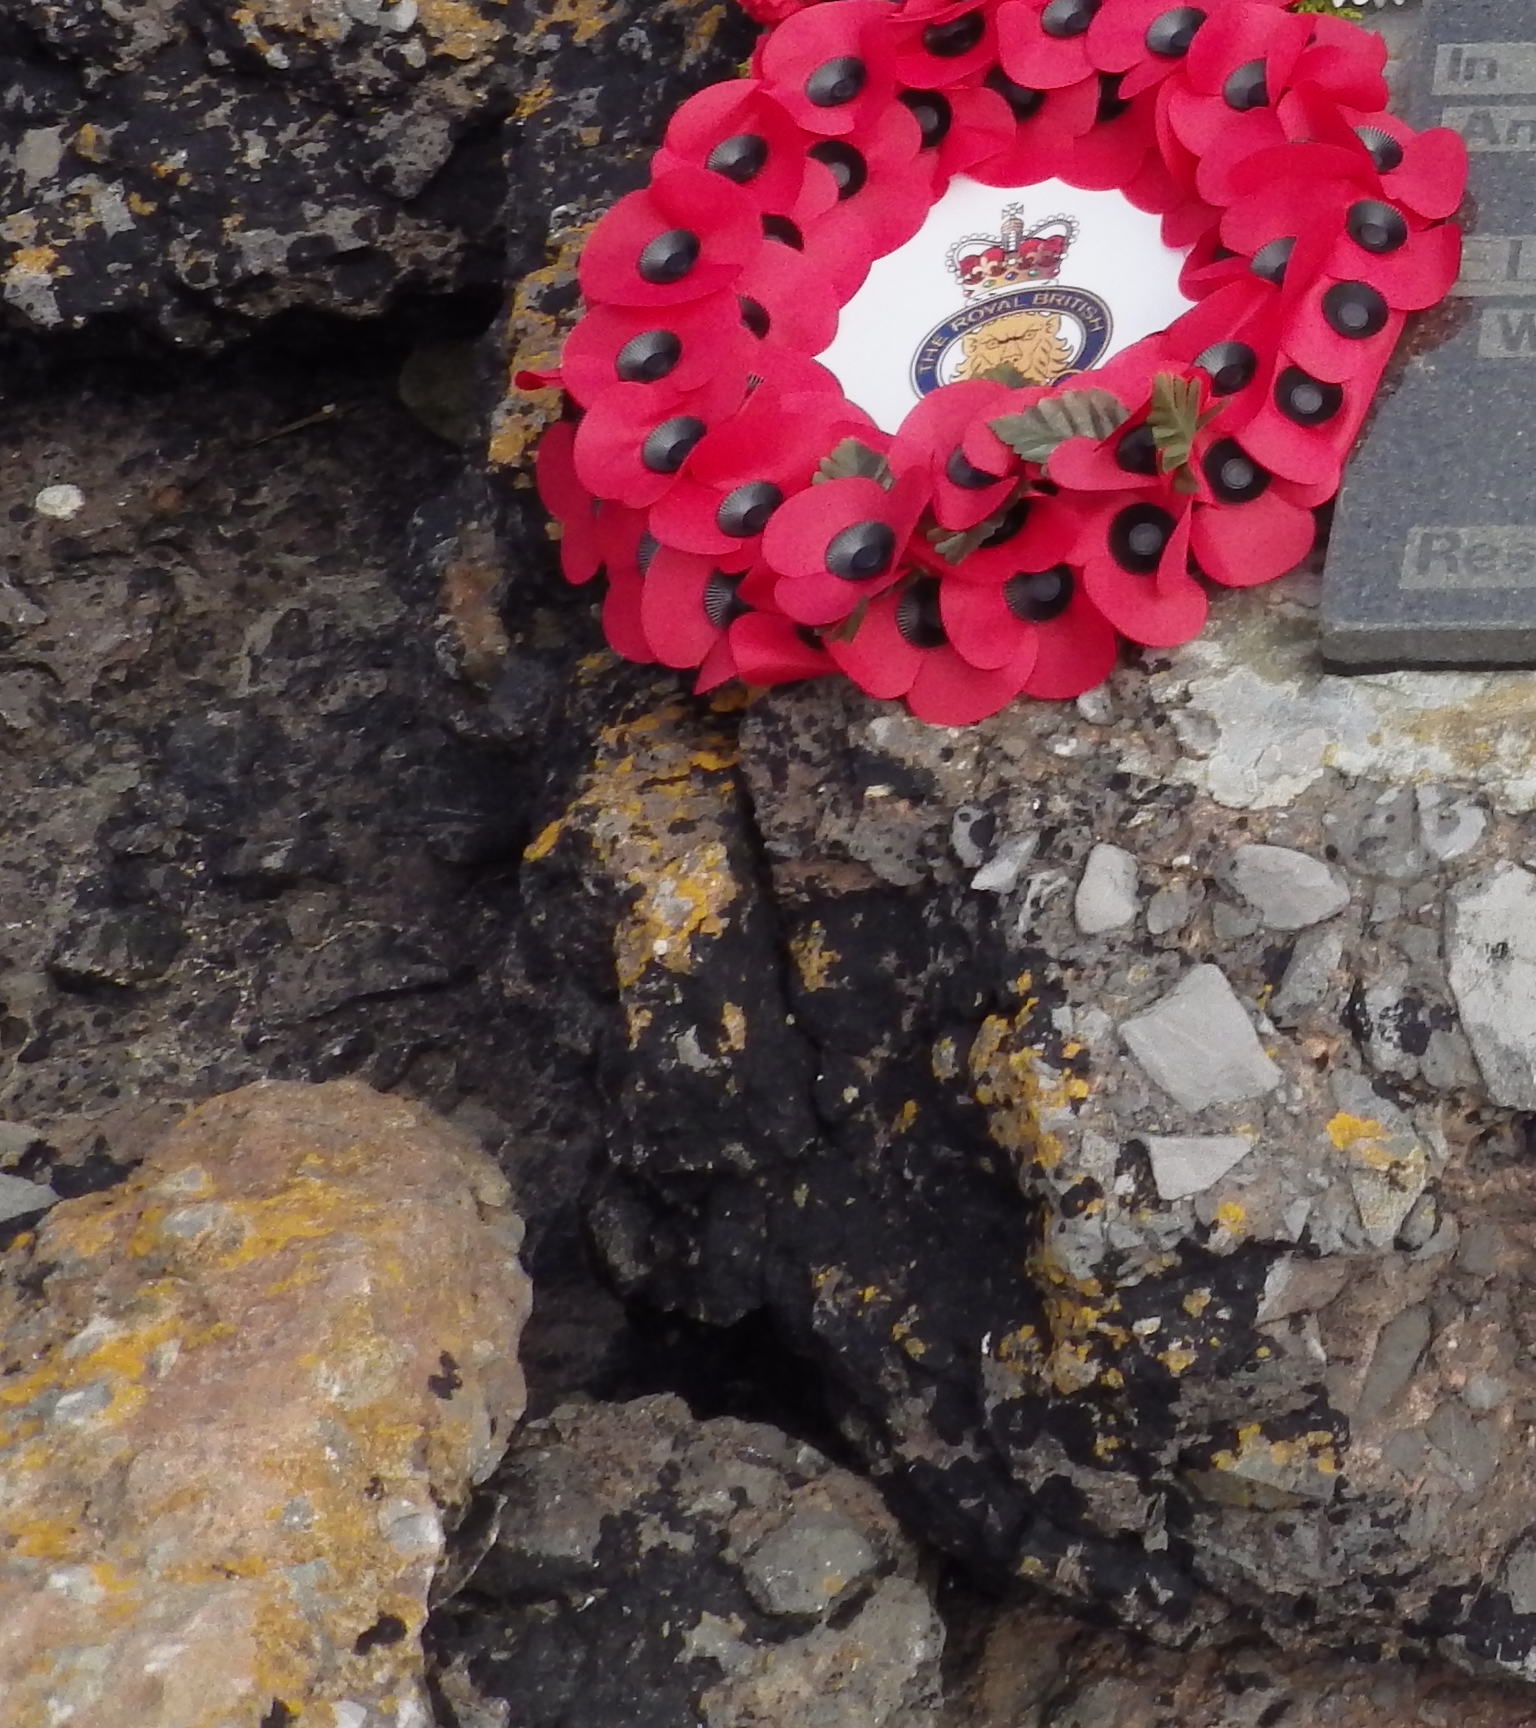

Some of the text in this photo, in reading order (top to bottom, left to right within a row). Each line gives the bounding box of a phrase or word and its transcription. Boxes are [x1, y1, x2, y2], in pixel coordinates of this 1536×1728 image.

[1448, 47, 1497, 82] In
[919, 292, 1105, 372] THE ROYAL BRITISH
